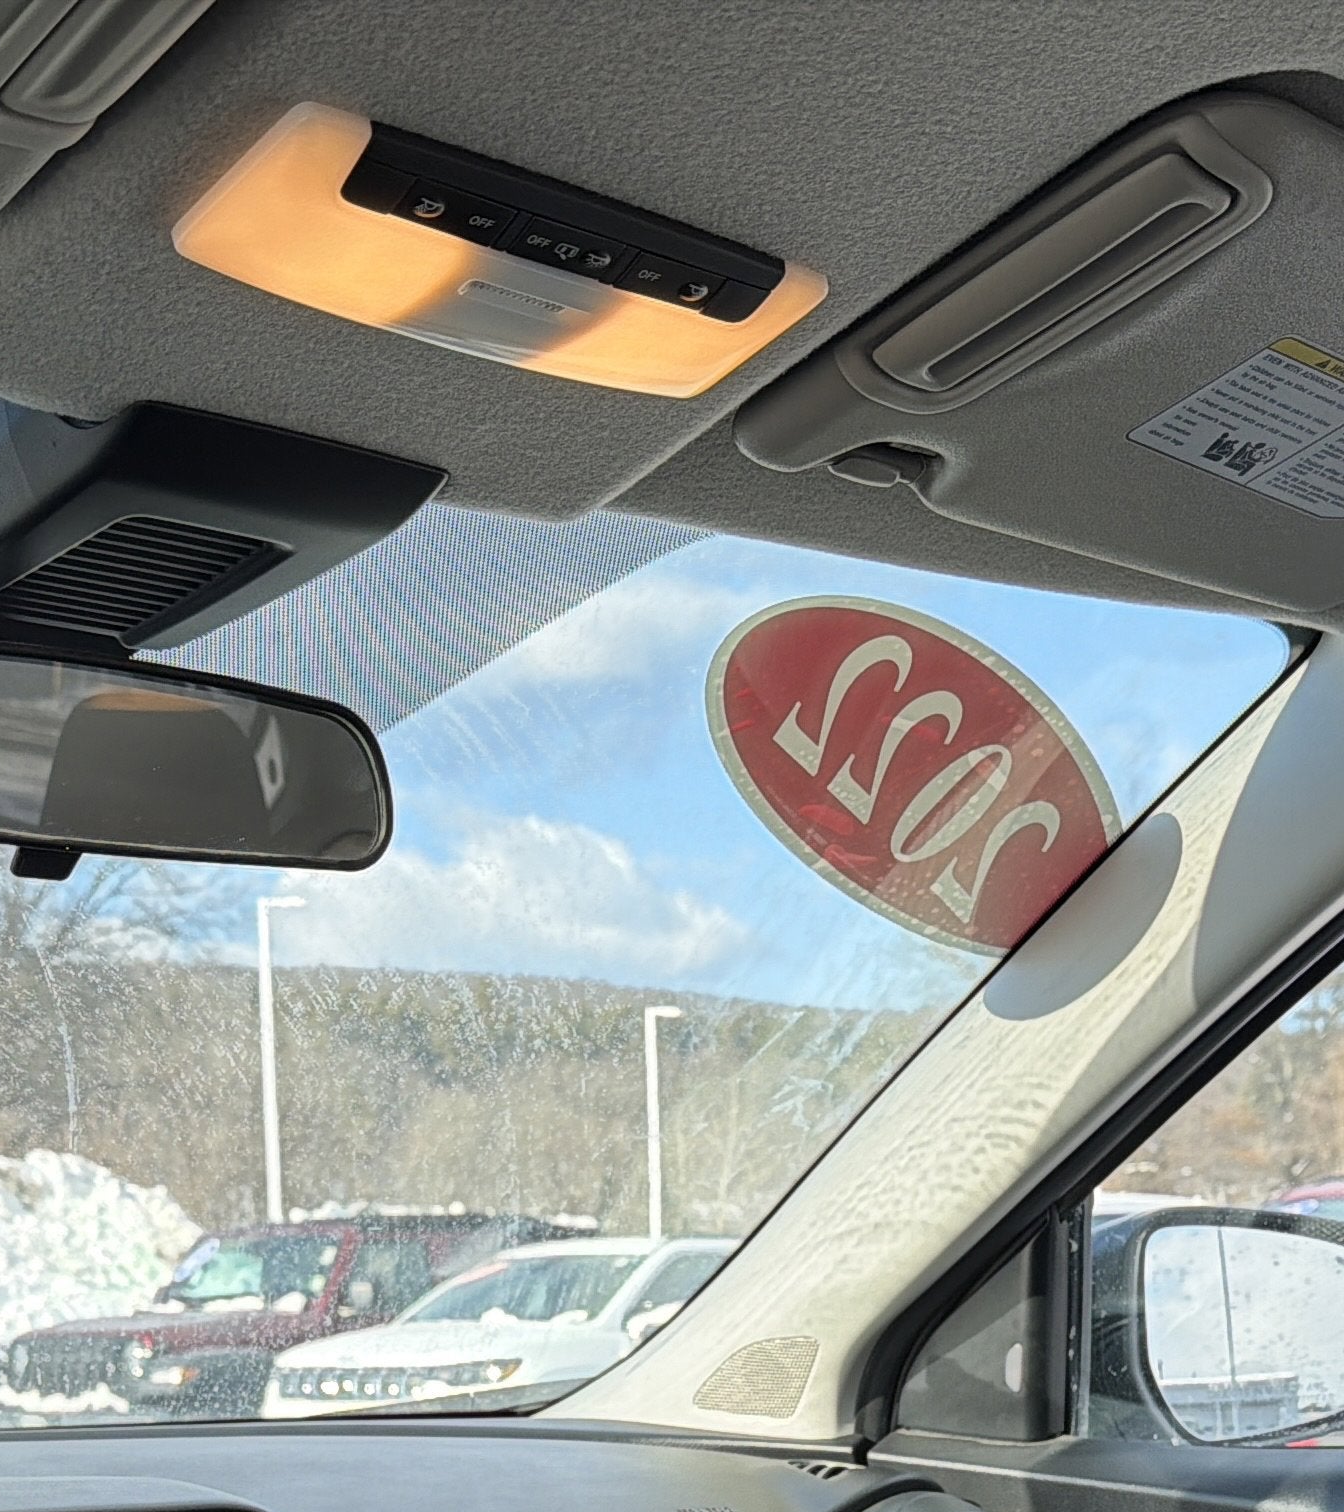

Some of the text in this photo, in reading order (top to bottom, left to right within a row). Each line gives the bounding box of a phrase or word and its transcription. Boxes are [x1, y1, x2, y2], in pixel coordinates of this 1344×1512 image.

[469, 215, 496, 229] OFF
[527, 234, 552, 248] OFF
[638, 269, 661, 281] OFF
